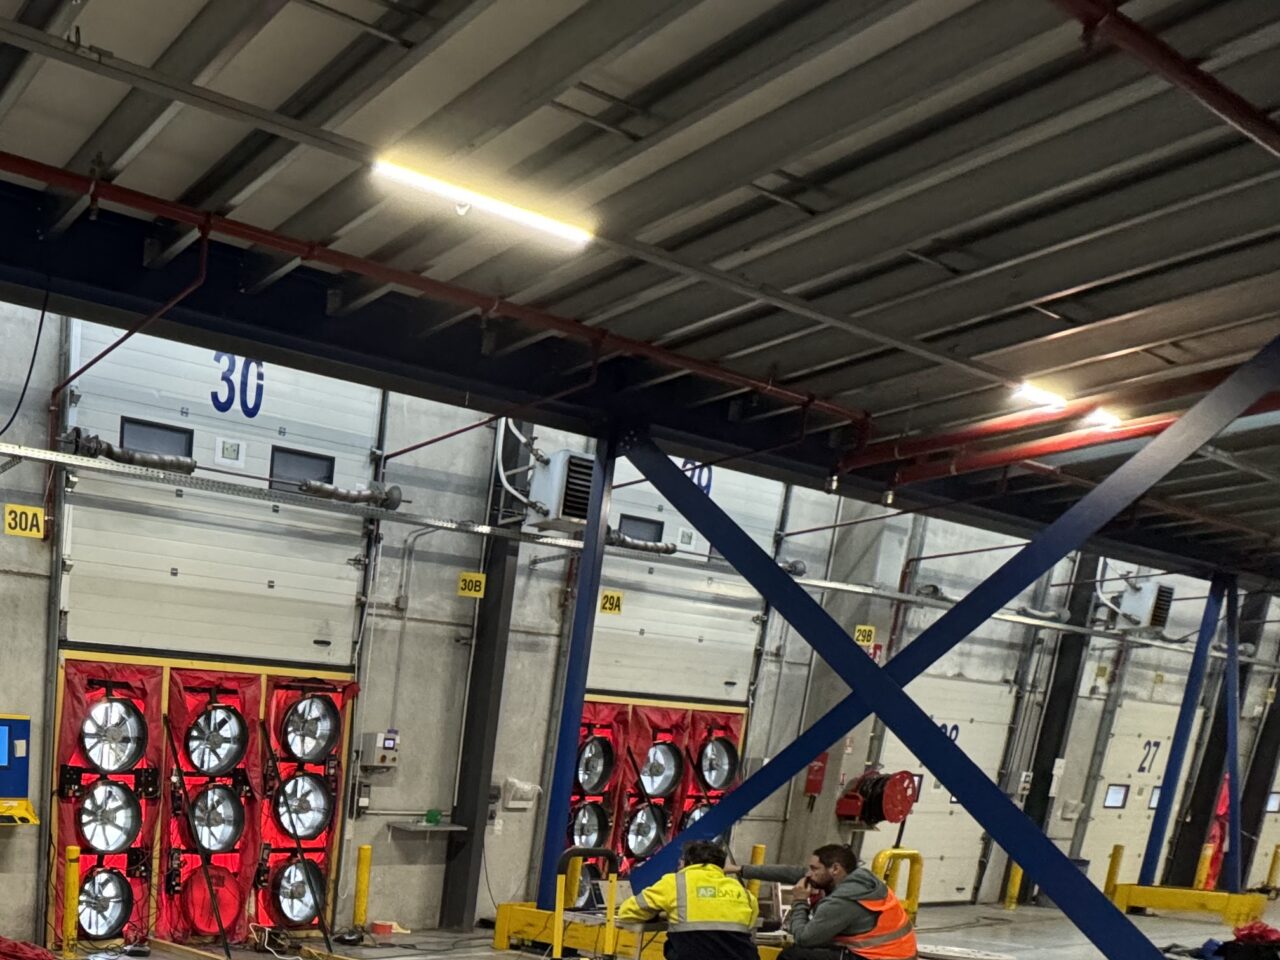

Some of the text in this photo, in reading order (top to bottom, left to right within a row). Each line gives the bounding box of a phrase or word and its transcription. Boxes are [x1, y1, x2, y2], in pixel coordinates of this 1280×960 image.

[211, 350, 264, 418] 30
[8, 510, 40, 533] 30A
[461, 579, 481, 592] 30B
[602, 595, 621, 611] 29A
[856, 629, 872, 642] 29B
[1137, 740, 1161, 773] 27
